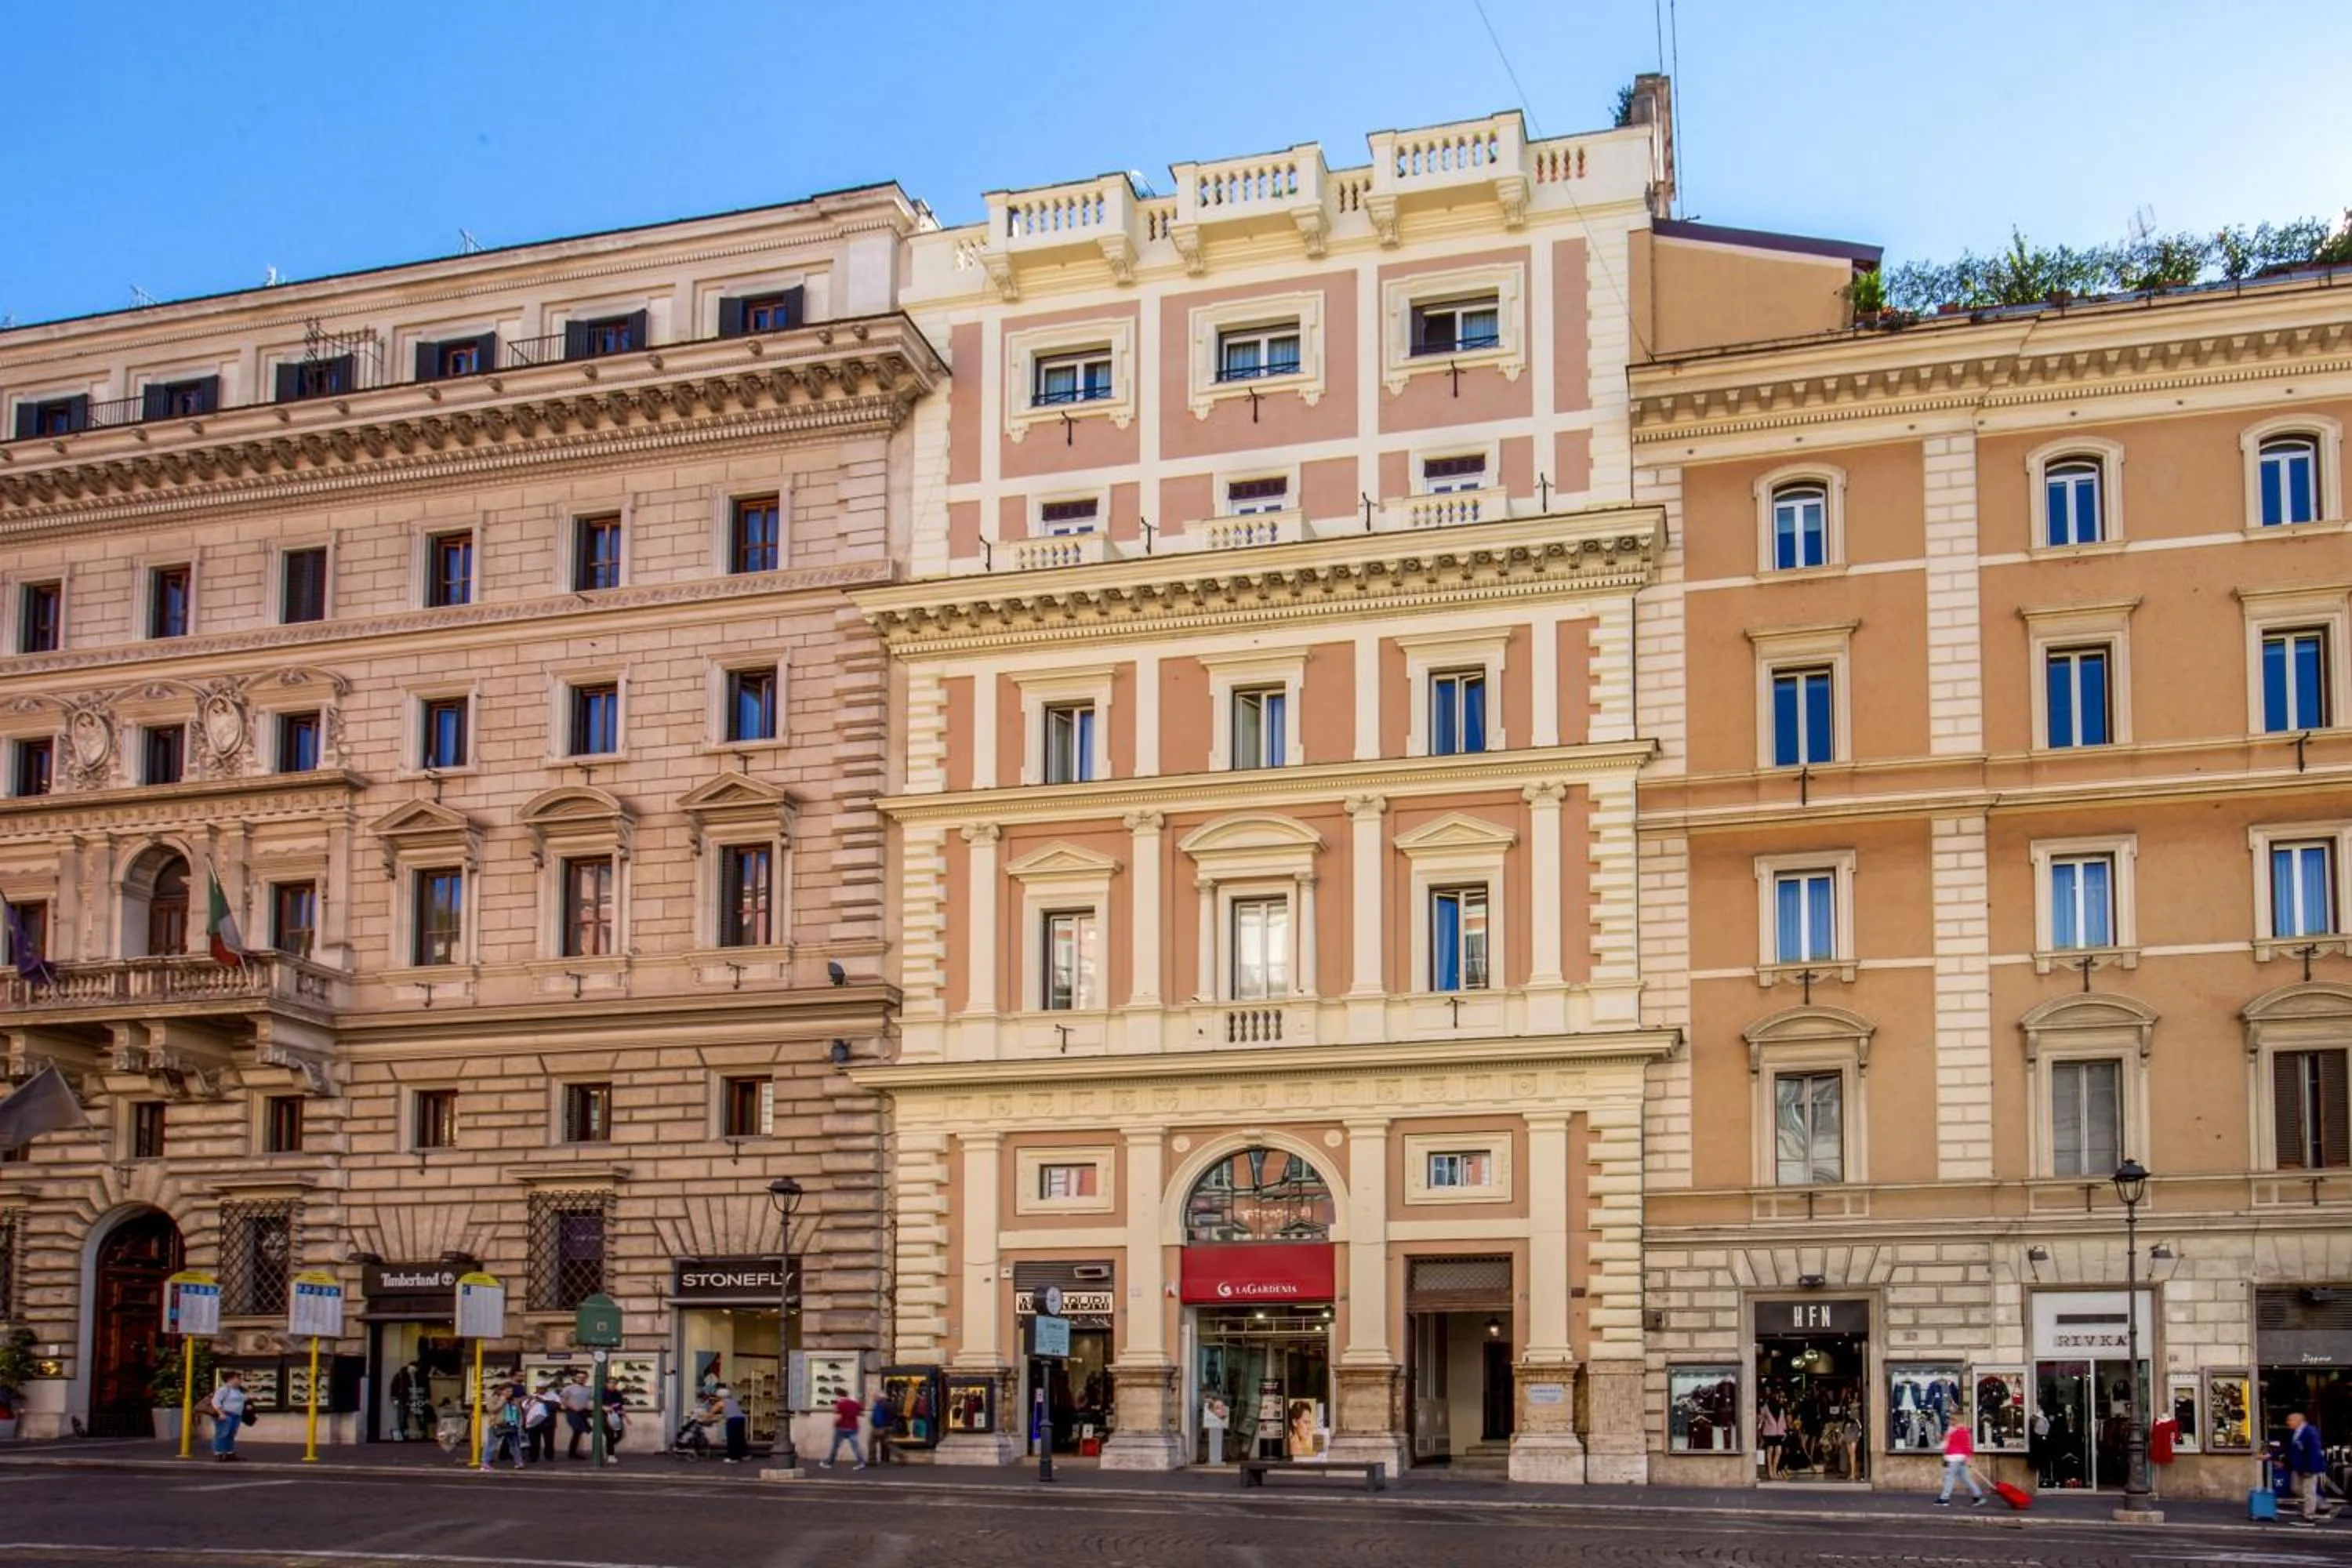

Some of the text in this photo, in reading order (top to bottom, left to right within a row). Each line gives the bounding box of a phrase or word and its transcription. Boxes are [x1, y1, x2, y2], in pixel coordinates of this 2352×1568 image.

[381, 1272, 440, 1287] Timberland
[681, 1272, 795, 1287] STONEFLY
[2057, 1334, 2129, 1347] RIVKA
